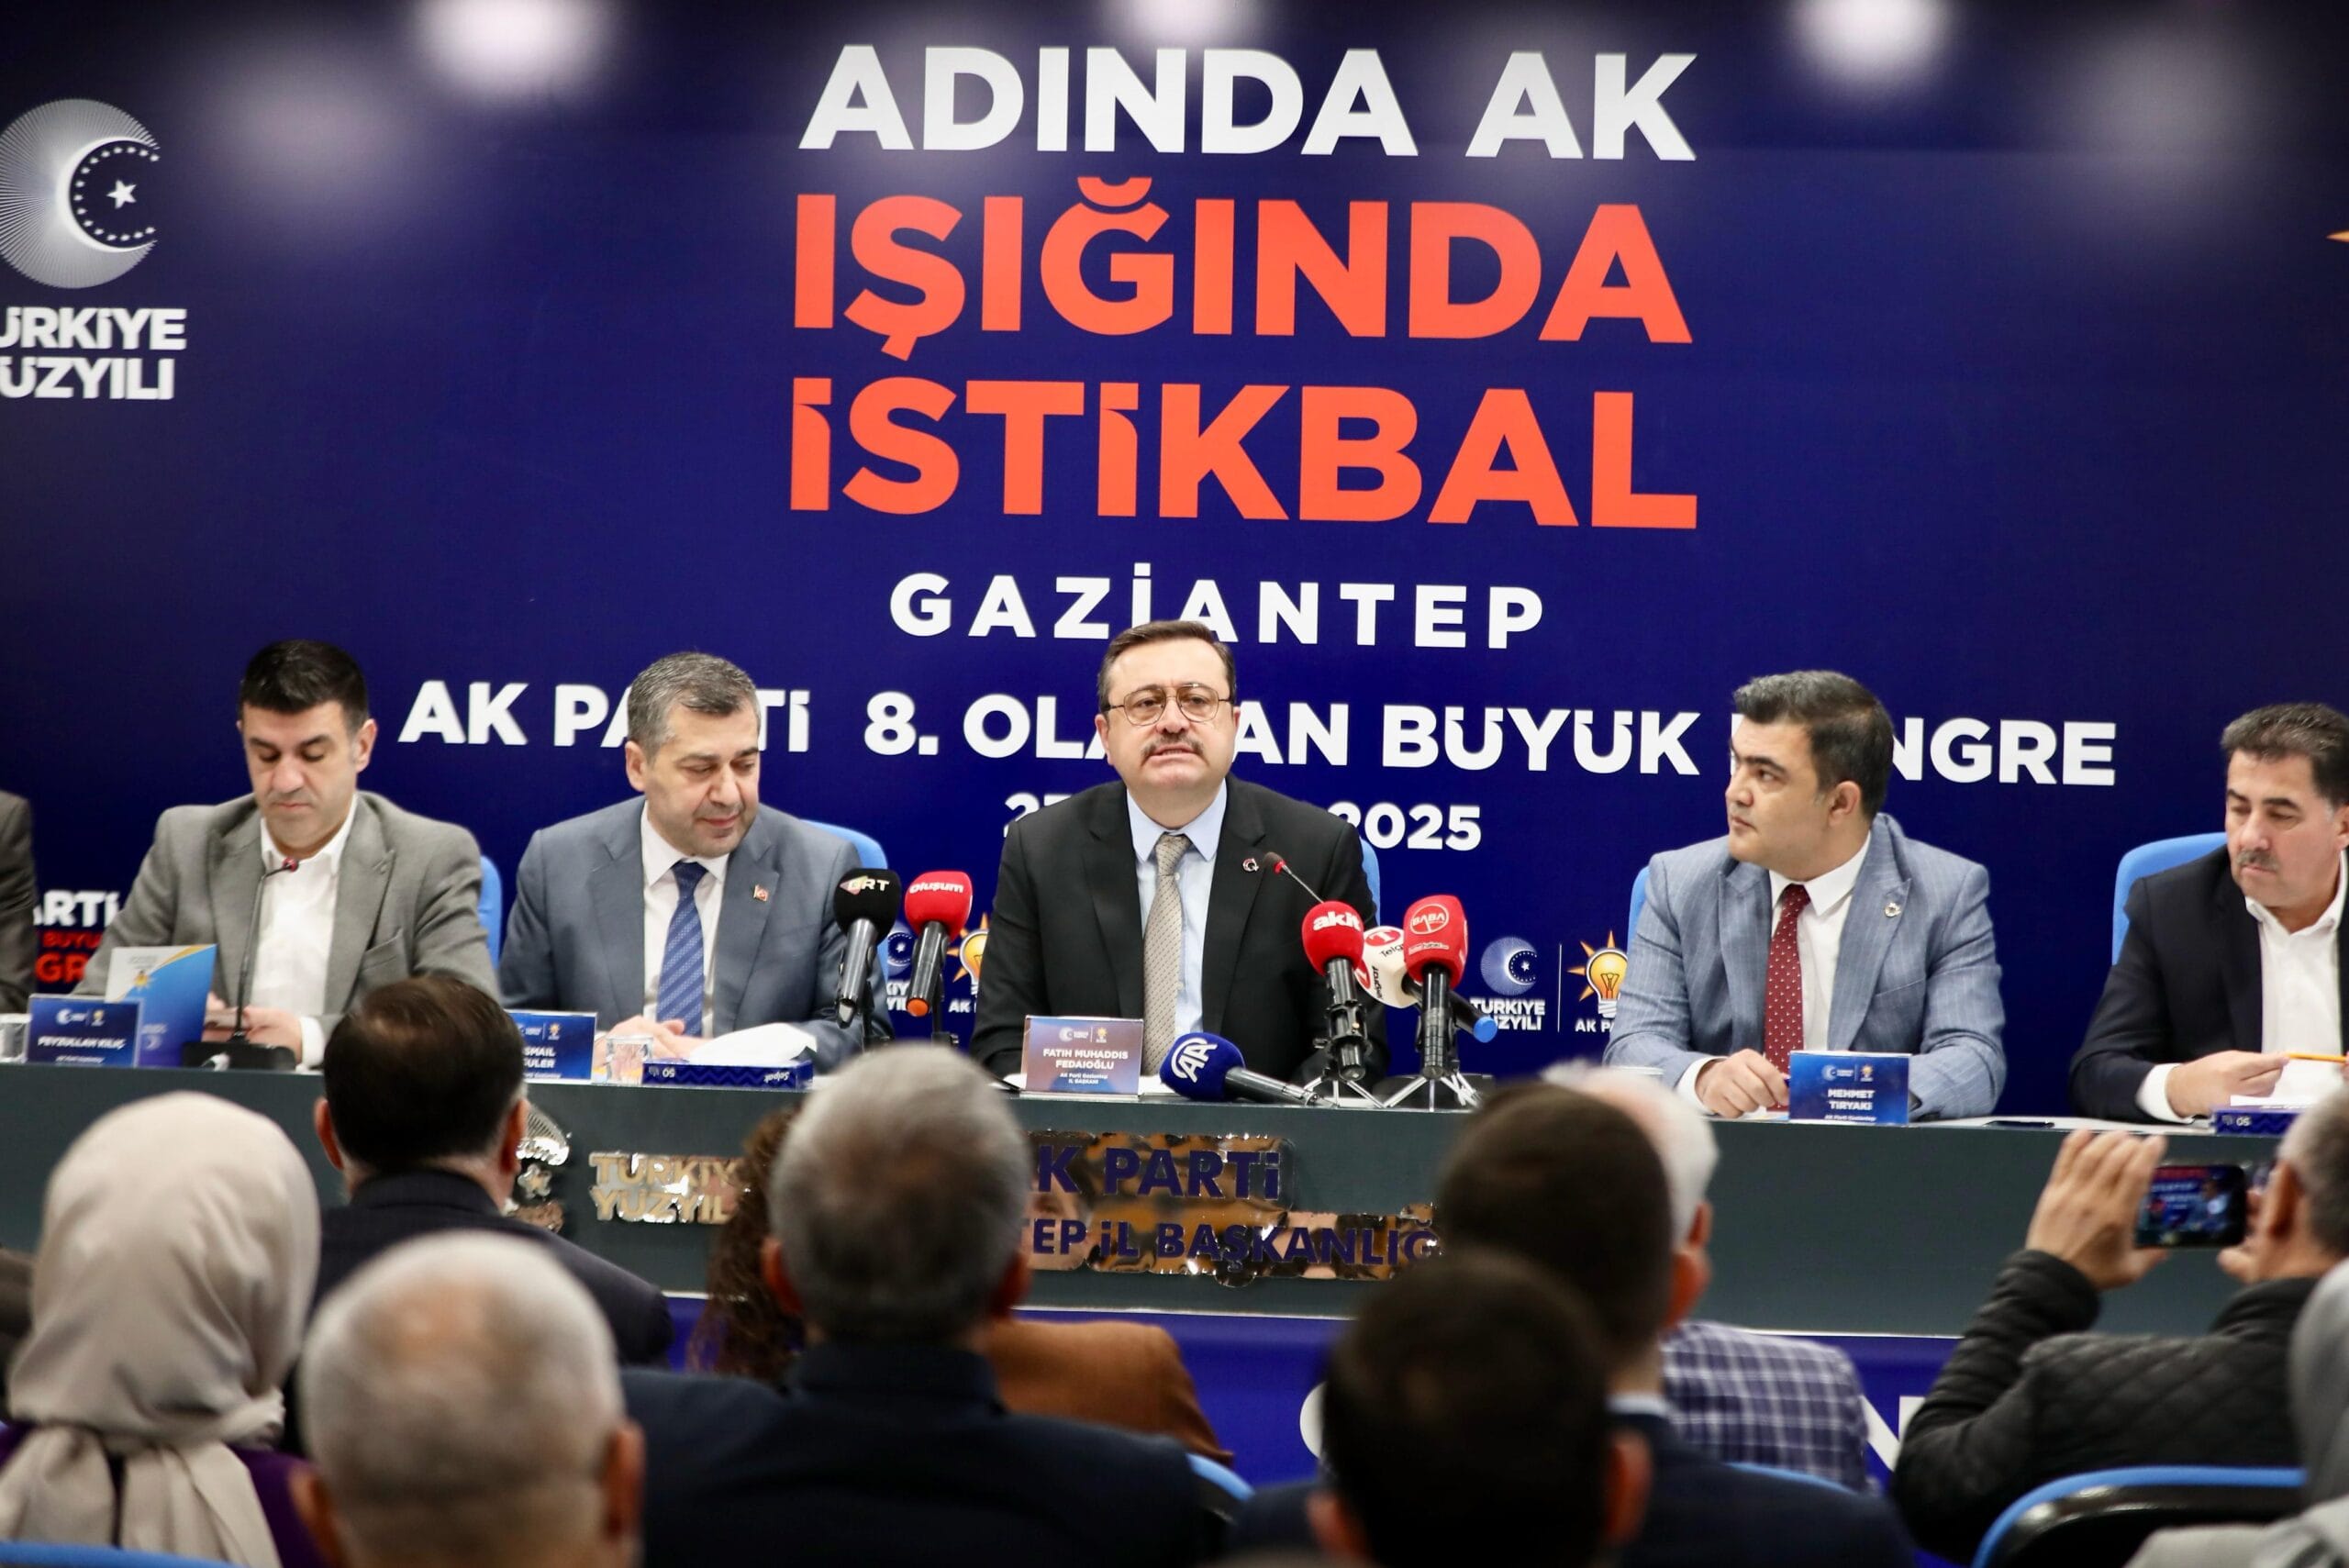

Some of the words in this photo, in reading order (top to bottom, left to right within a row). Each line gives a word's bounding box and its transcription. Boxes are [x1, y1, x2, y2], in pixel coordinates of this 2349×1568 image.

[798, 44, 1419, 157] ADINDA
[1465, 51, 1698, 161] AK
[794, 176, 1693, 361] IŞIĞINDA
[0, 306, 187, 350] ÜRKİYE
[0, 356, 175, 400] ÜZYILI
[790, 376, 1698, 529] İSTİKBAL
[890, 562, 1542, 649] GAZİANTEP
[398, 679, 527, 747] AK
[554, 683, 810, 752] PTİ
[864, 691, 939, 756] 8.
[963, 694, 1349, 766] OLAN
[1382, 704, 1699, 776] BÜYÜK
[1731, 712, 2117, 786] NGRE
[33, 889, 120, 928] RTİ
[1312, 910, 1362, 931] akit
[1379, 943, 1404, 958] Telg
[948, 999, 971, 1013] AK
[1495, 1015, 1542, 1030] ZYILI
[1575, 1019, 1597, 1032] AK
[1036, 1143, 1083, 1194] K
[1156, 1219, 1439, 1273] BAŞKANLIĞ
